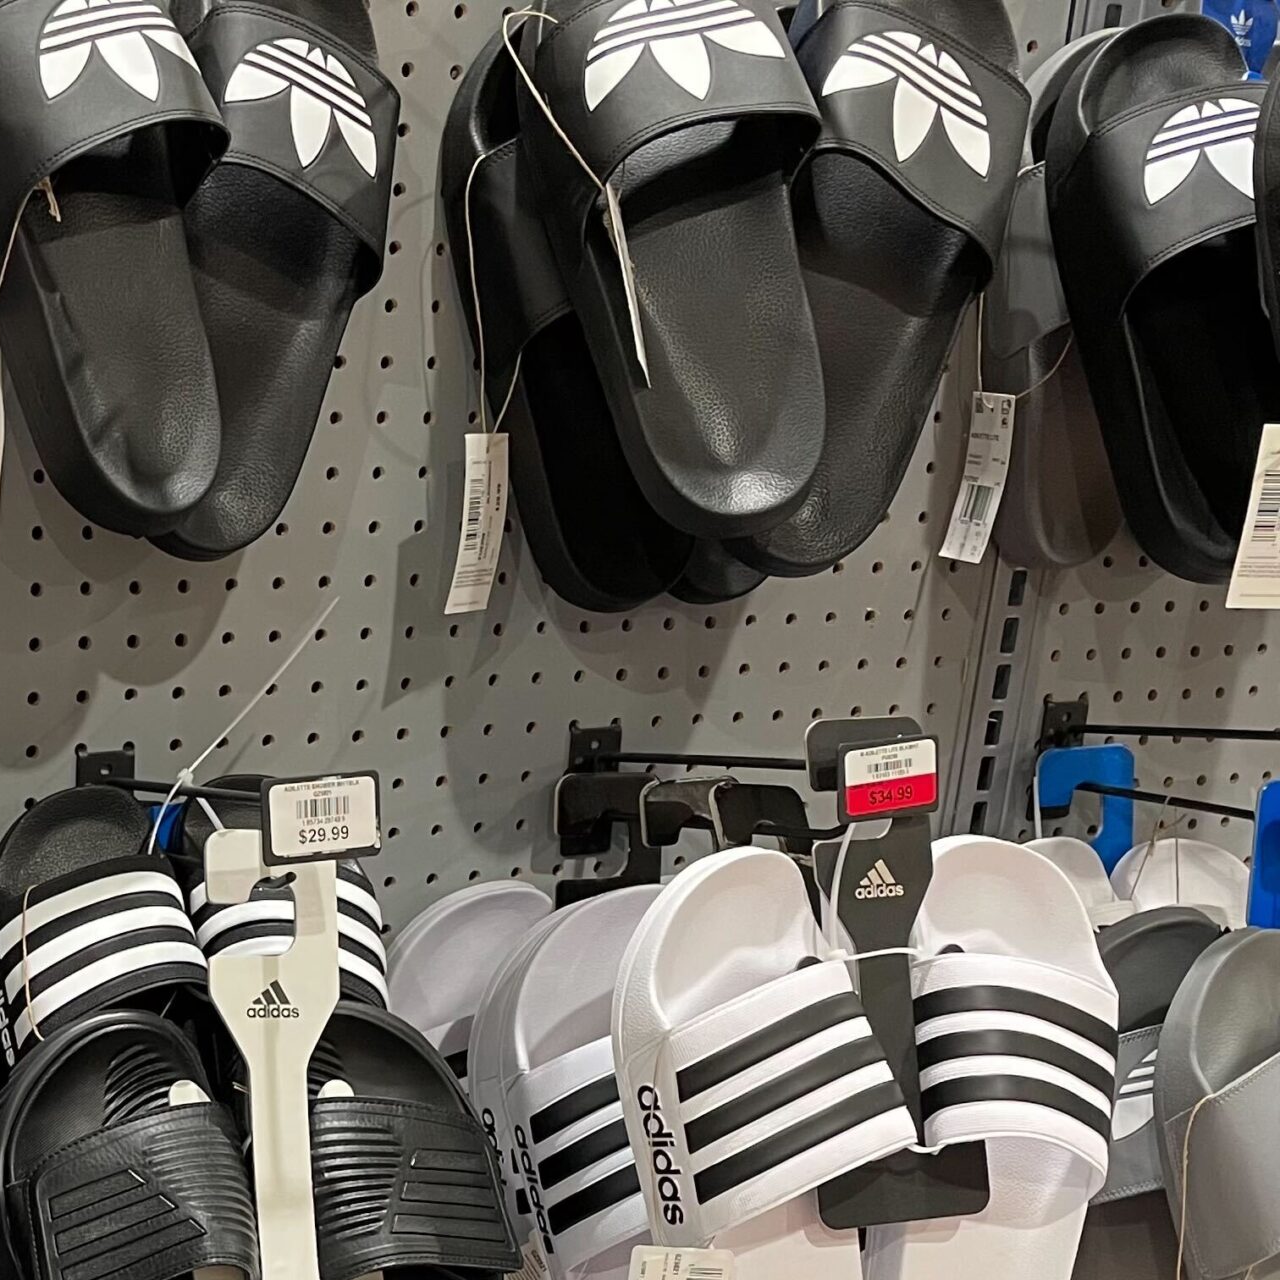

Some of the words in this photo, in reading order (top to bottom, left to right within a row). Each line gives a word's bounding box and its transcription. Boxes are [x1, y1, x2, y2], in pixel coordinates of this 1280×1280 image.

[299, 825, 349, 844] $29.99
[855, 884, 904, 899] adidas
[246, 1004, 300, 1018] adidas
[638, 1085, 684, 1225] adidas
